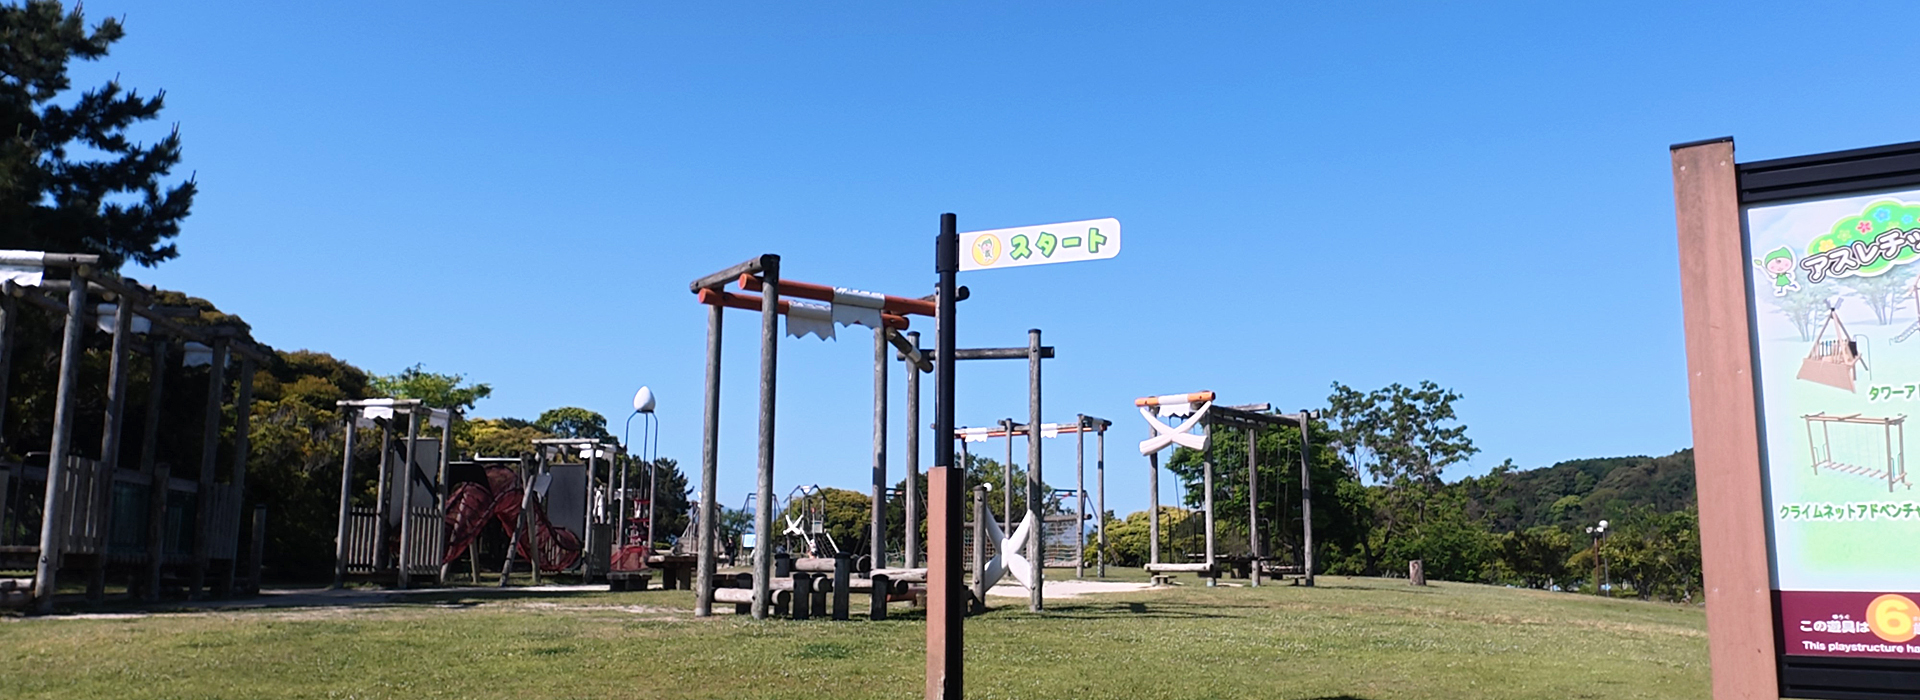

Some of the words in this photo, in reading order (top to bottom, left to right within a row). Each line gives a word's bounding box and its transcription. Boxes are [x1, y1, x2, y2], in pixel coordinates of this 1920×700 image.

[1009, 227, 1107, 260] スタート
[1869, 384, 1920, 401] タワーア
[1875, 599, 1912, 635] 6
[1802, 640, 1826, 651] This
[1828, 641, 1904, 653] playstructure
